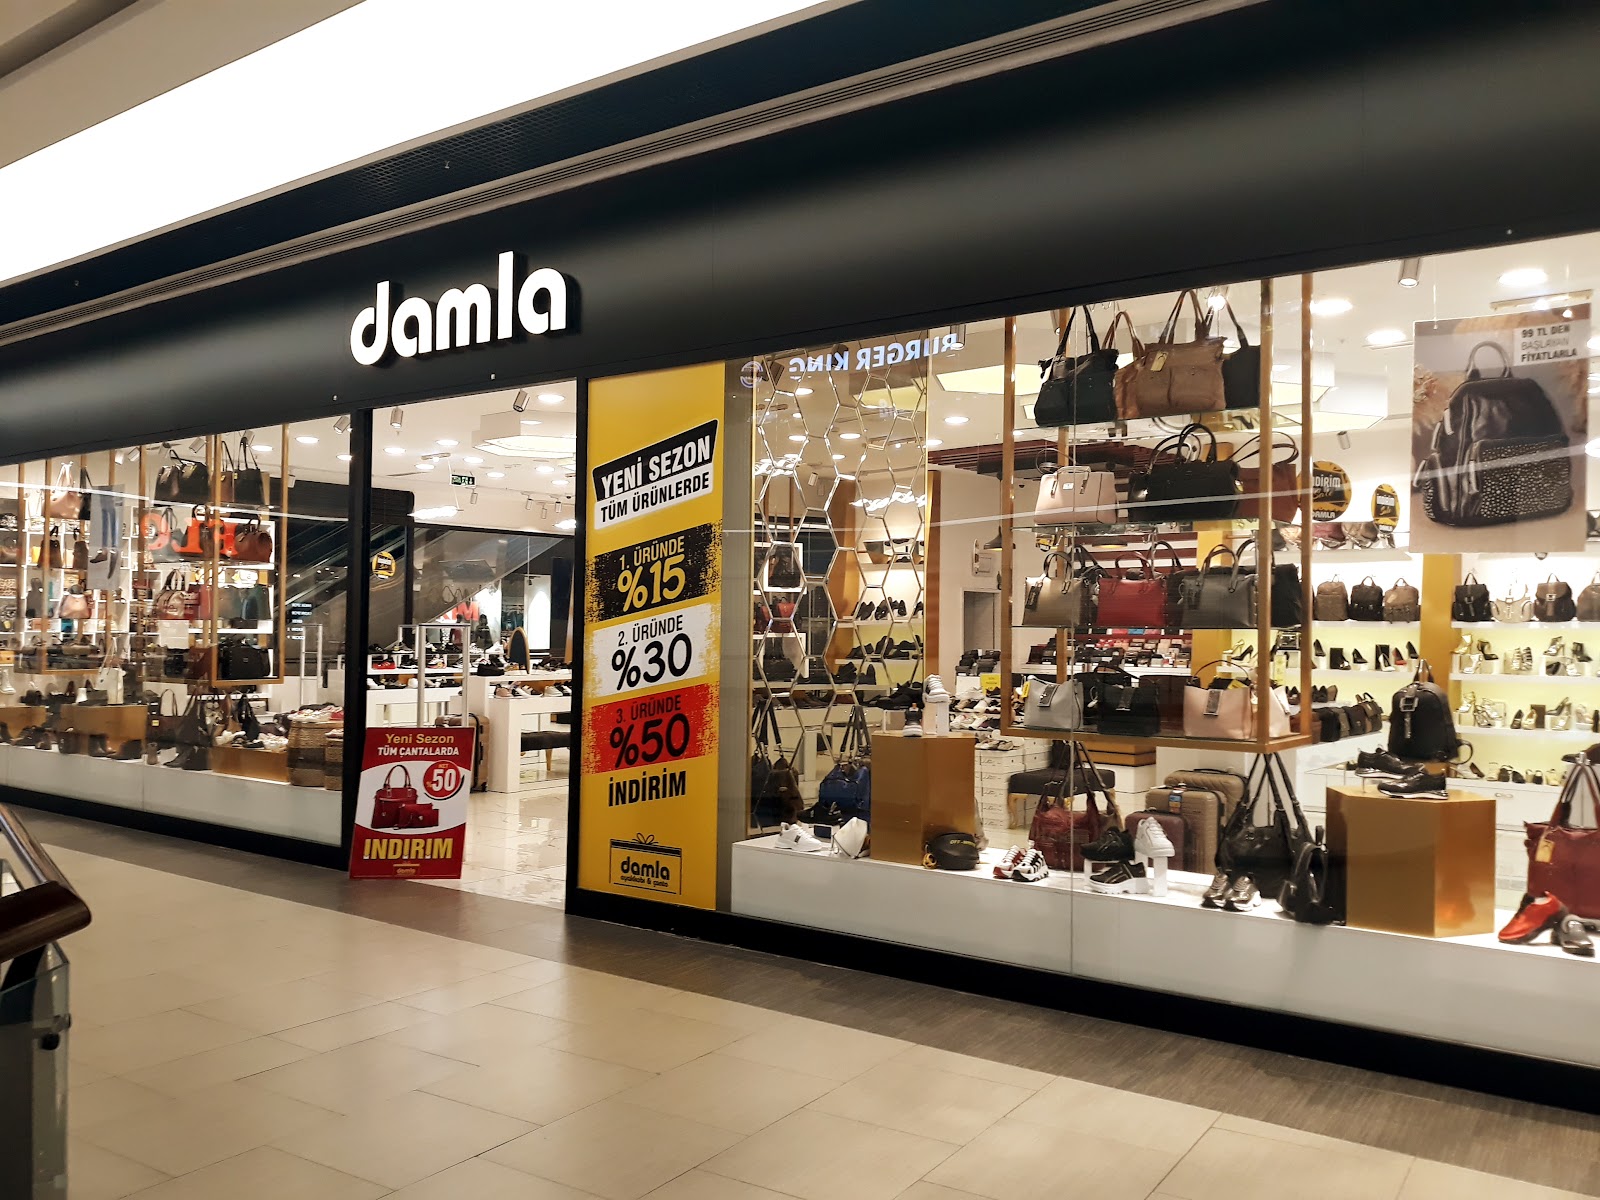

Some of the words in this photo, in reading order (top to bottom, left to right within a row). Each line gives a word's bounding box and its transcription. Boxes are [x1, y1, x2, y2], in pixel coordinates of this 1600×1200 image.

[350, 250, 567, 366] damla
[1522, 328, 1534, 339] 99
[1537, 327, 1548, 337] TL
[601, 458, 644, 499] YENİ
[648, 435, 710, 482] SEZON
[600, 498, 629, 523] TÜM
[632, 471, 710, 513] ÜRÜNLERDE
[620, 556, 631, 571] 1.
[634, 536, 685, 567] ÜRÜNDE
[617, 554, 686, 613] %15
[618, 630, 631, 647] 2.
[632, 614, 684, 643] ÜRÜNDE
[611, 632, 693, 691] %30
[616, 708, 627, 724] 3.
[631, 694, 682, 721] ÜRÜNDE
[377, 744, 399, 756] TÜM
[399, 746, 460, 758] ÇANTALARDA
[385, 733, 413, 744] Yeni
[415, 733, 454, 744] Sezon
[610, 712, 691, 769] %50
[608, 767, 687, 807] İNDİRİM
[620, 855, 671, 882] damla
